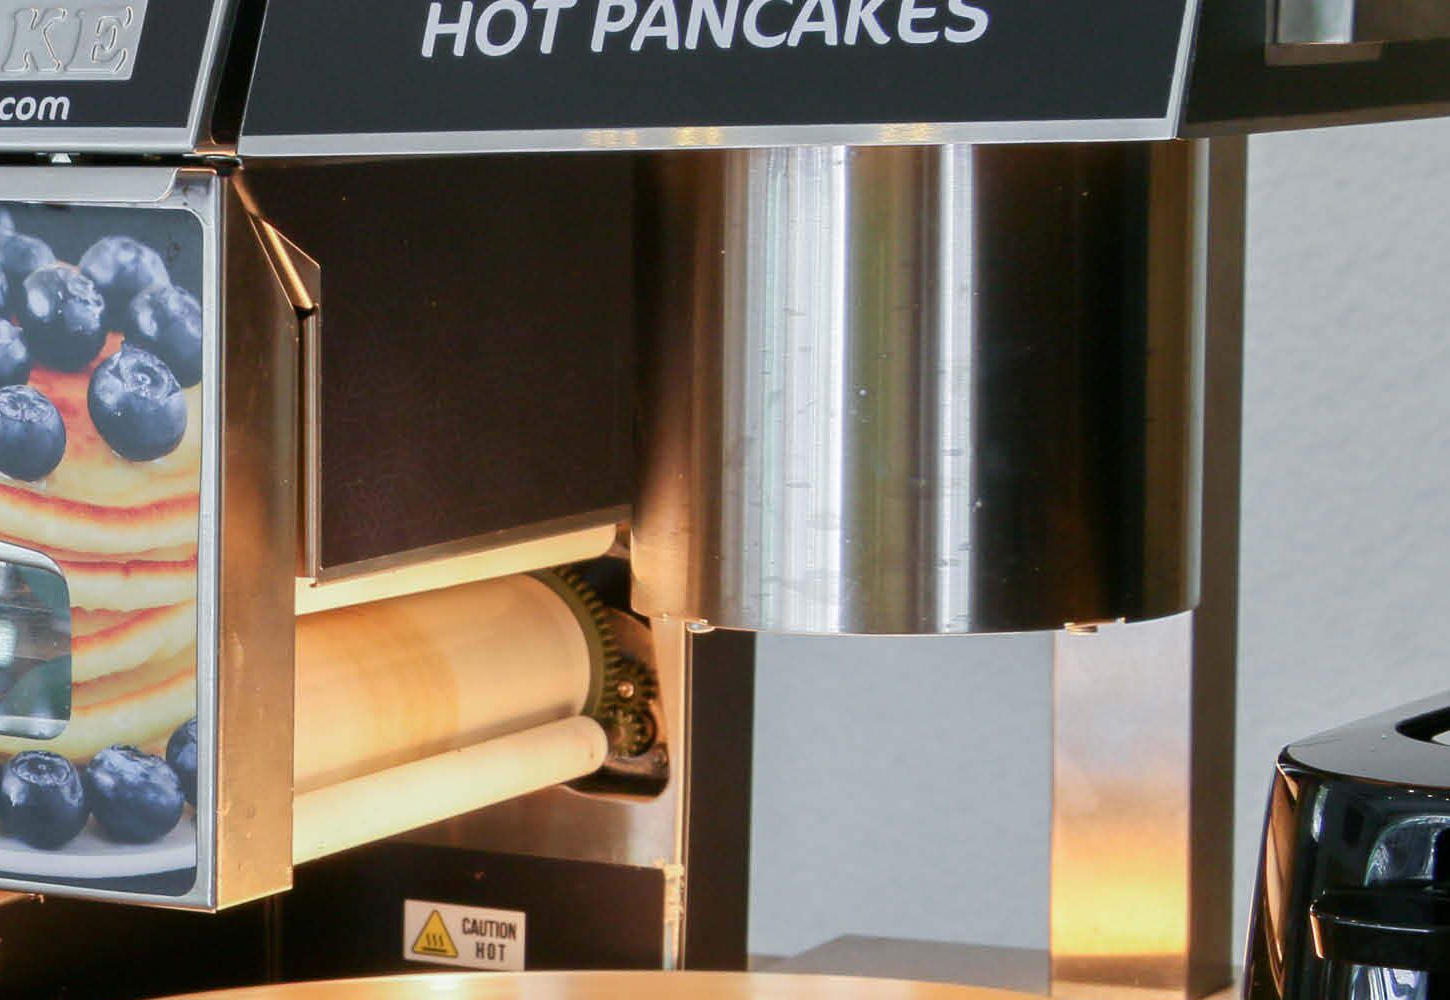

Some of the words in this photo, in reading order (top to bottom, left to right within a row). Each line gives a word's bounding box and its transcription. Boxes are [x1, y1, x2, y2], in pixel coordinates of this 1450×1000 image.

[421, 0, 578, 58] HOT
[590, 0, 989, 53] PANCAKES
[461, 917, 517, 940] CAUTION
[475, 941, 506, 961] HOT
